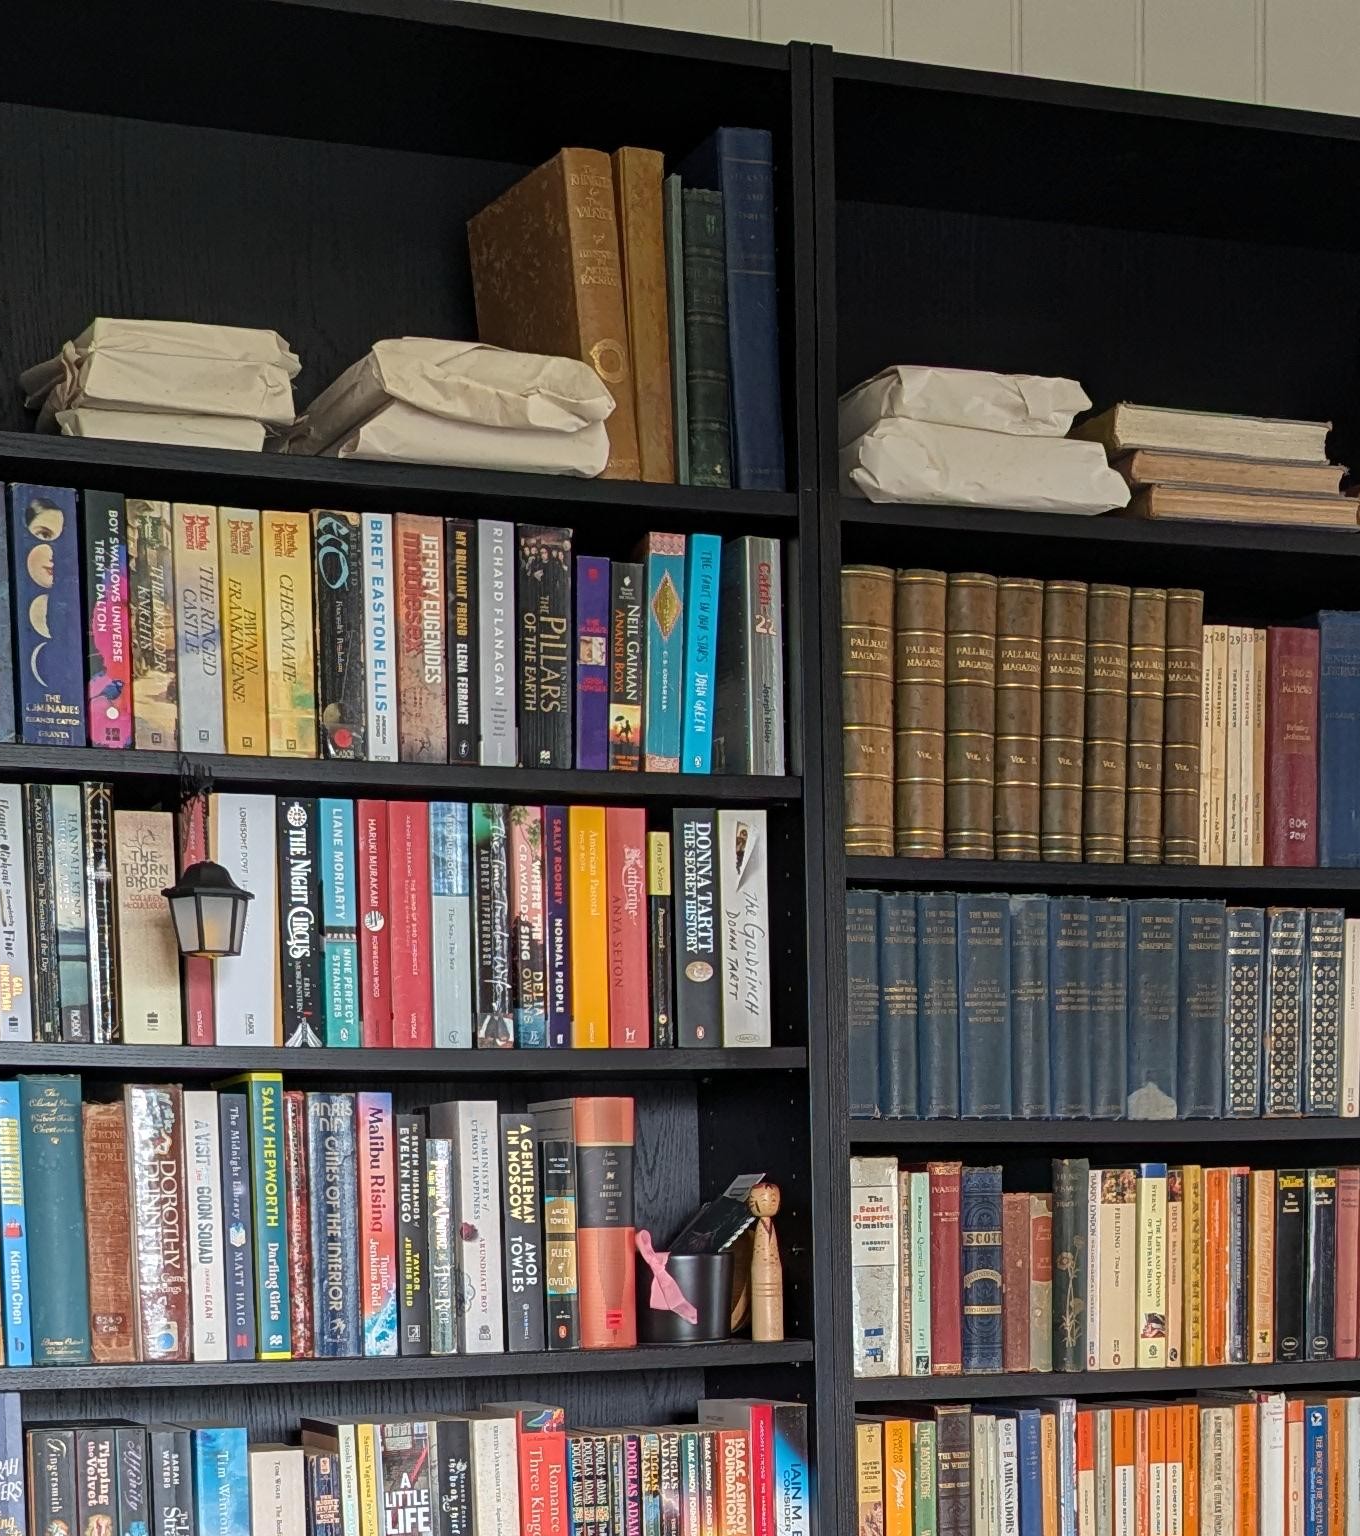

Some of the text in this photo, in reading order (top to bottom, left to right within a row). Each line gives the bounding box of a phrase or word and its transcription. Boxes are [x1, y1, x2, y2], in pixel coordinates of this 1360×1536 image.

[369, 519, 388, 712] BRET EASTON ELLIS
[492, 528, 506, 697] RICHARD FLANAGAN
[121, 849, 169, 889] THE THORN BIRDS
[695, 822, 713, 954] DONNA TARTT
[260, 1087, 279, 1228] SALLY HEPWORTH
[367, 1106, 385, 1234] Malibu Rising
[385, 1473, 430, 1534] A LITTLE LIFE
[790, 1463, 801, 1495] IAIN
[790, 1501, 802, 1519] M.
[1003, 1461, 1015, 1535] AMBASSADORS
